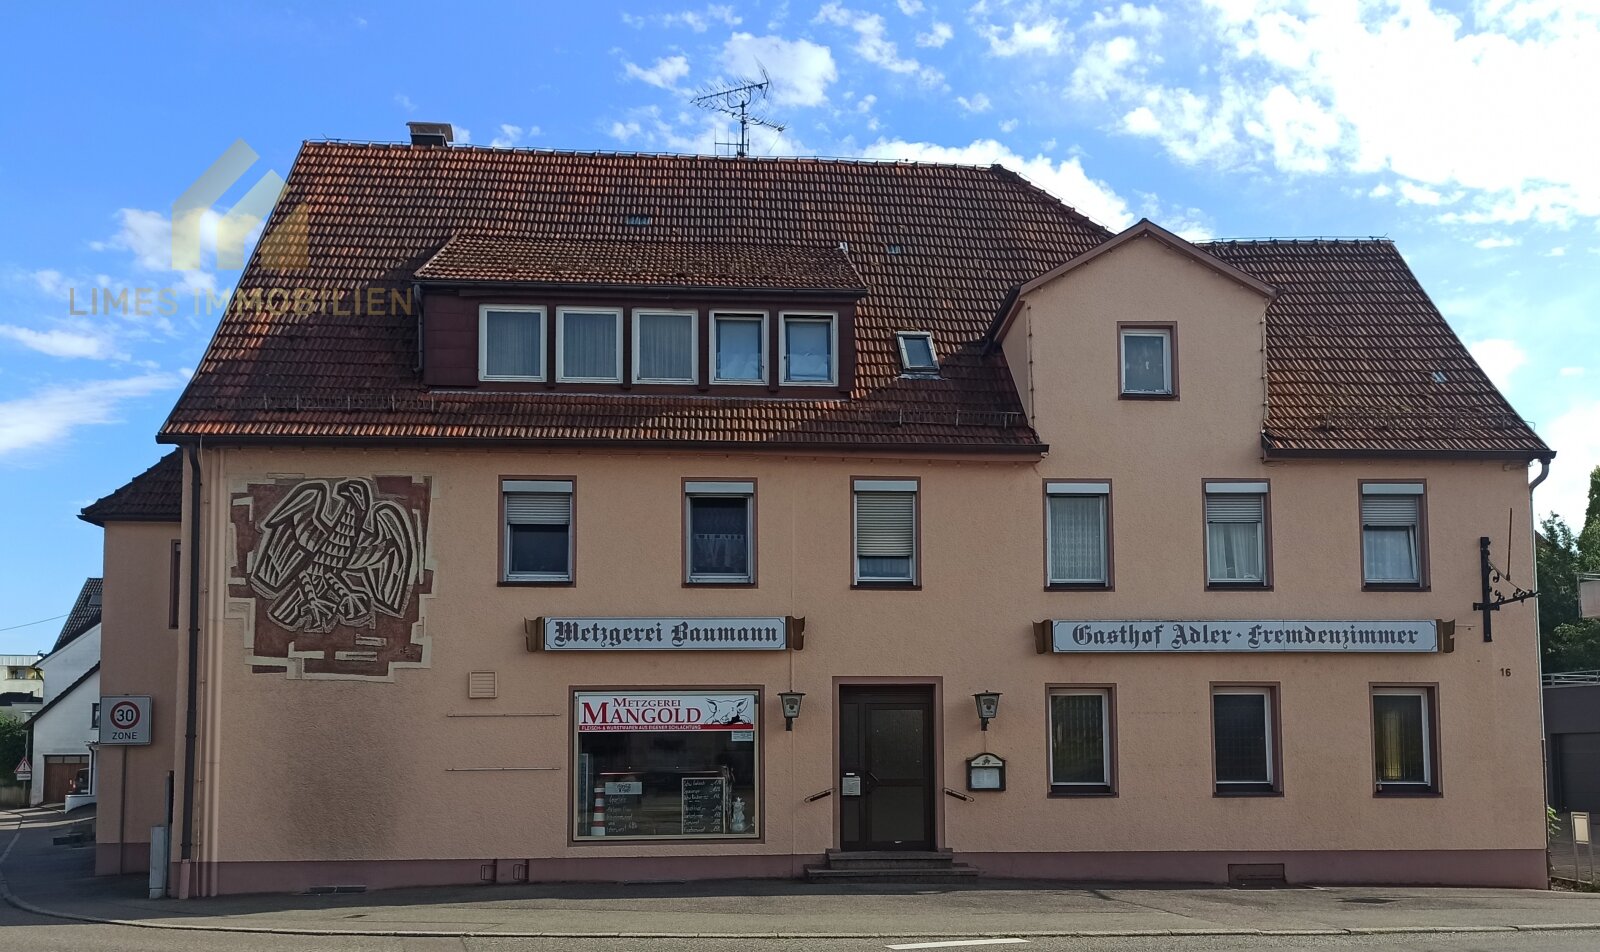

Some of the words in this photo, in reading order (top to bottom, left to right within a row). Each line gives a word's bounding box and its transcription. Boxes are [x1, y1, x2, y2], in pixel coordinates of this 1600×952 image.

[554, 621, 663, 648] Metzgerei
[671, 621, 778, 647] Baumann
[1072, 623, 1164, 649] Gasthof
[1170, 623, 1232, 649] Adler
[1247, 624, 1419, 649] Fremdenzimmer
[1500, 667, 1512, 677] 16
[613, 698, 681, 708] METZGEREI
[116, 709, 134, 722] 30
[581, 702, 702, 724] MANGOLD
[112, 732, 138, 740] ZONE
